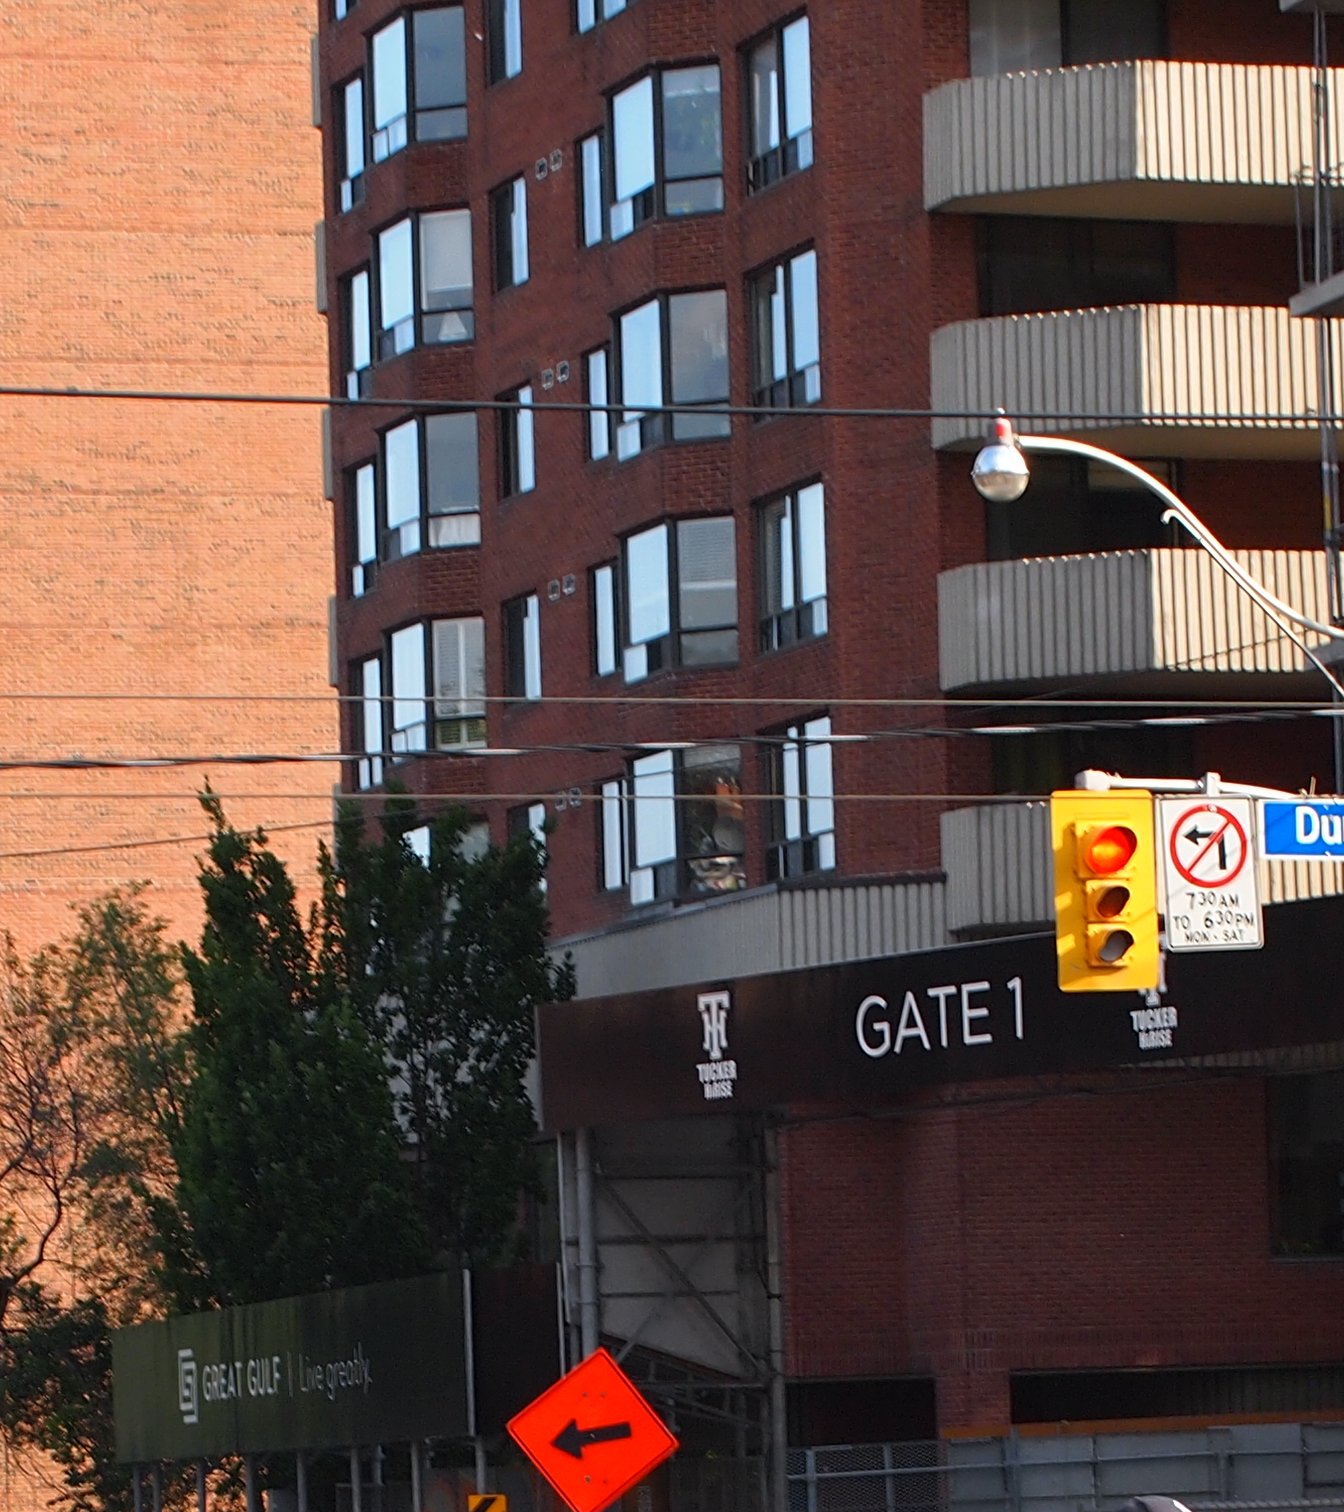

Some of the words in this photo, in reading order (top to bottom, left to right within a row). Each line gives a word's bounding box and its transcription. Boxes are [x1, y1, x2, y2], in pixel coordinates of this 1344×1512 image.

[1172, 915, 1190, 930] TO
[856, 981, 993, 1058] GATE
[1006, 976, 1024, 1040] 1
[1130, 1006, 1179, 1032] TUCKER
[696, 1060, 737, 1083] TUCKER
[202, 1361, 243, 1401] GREAT
[247, 1355, 281, 1397] GULF
[299, 1352, 325, 1392] Live
